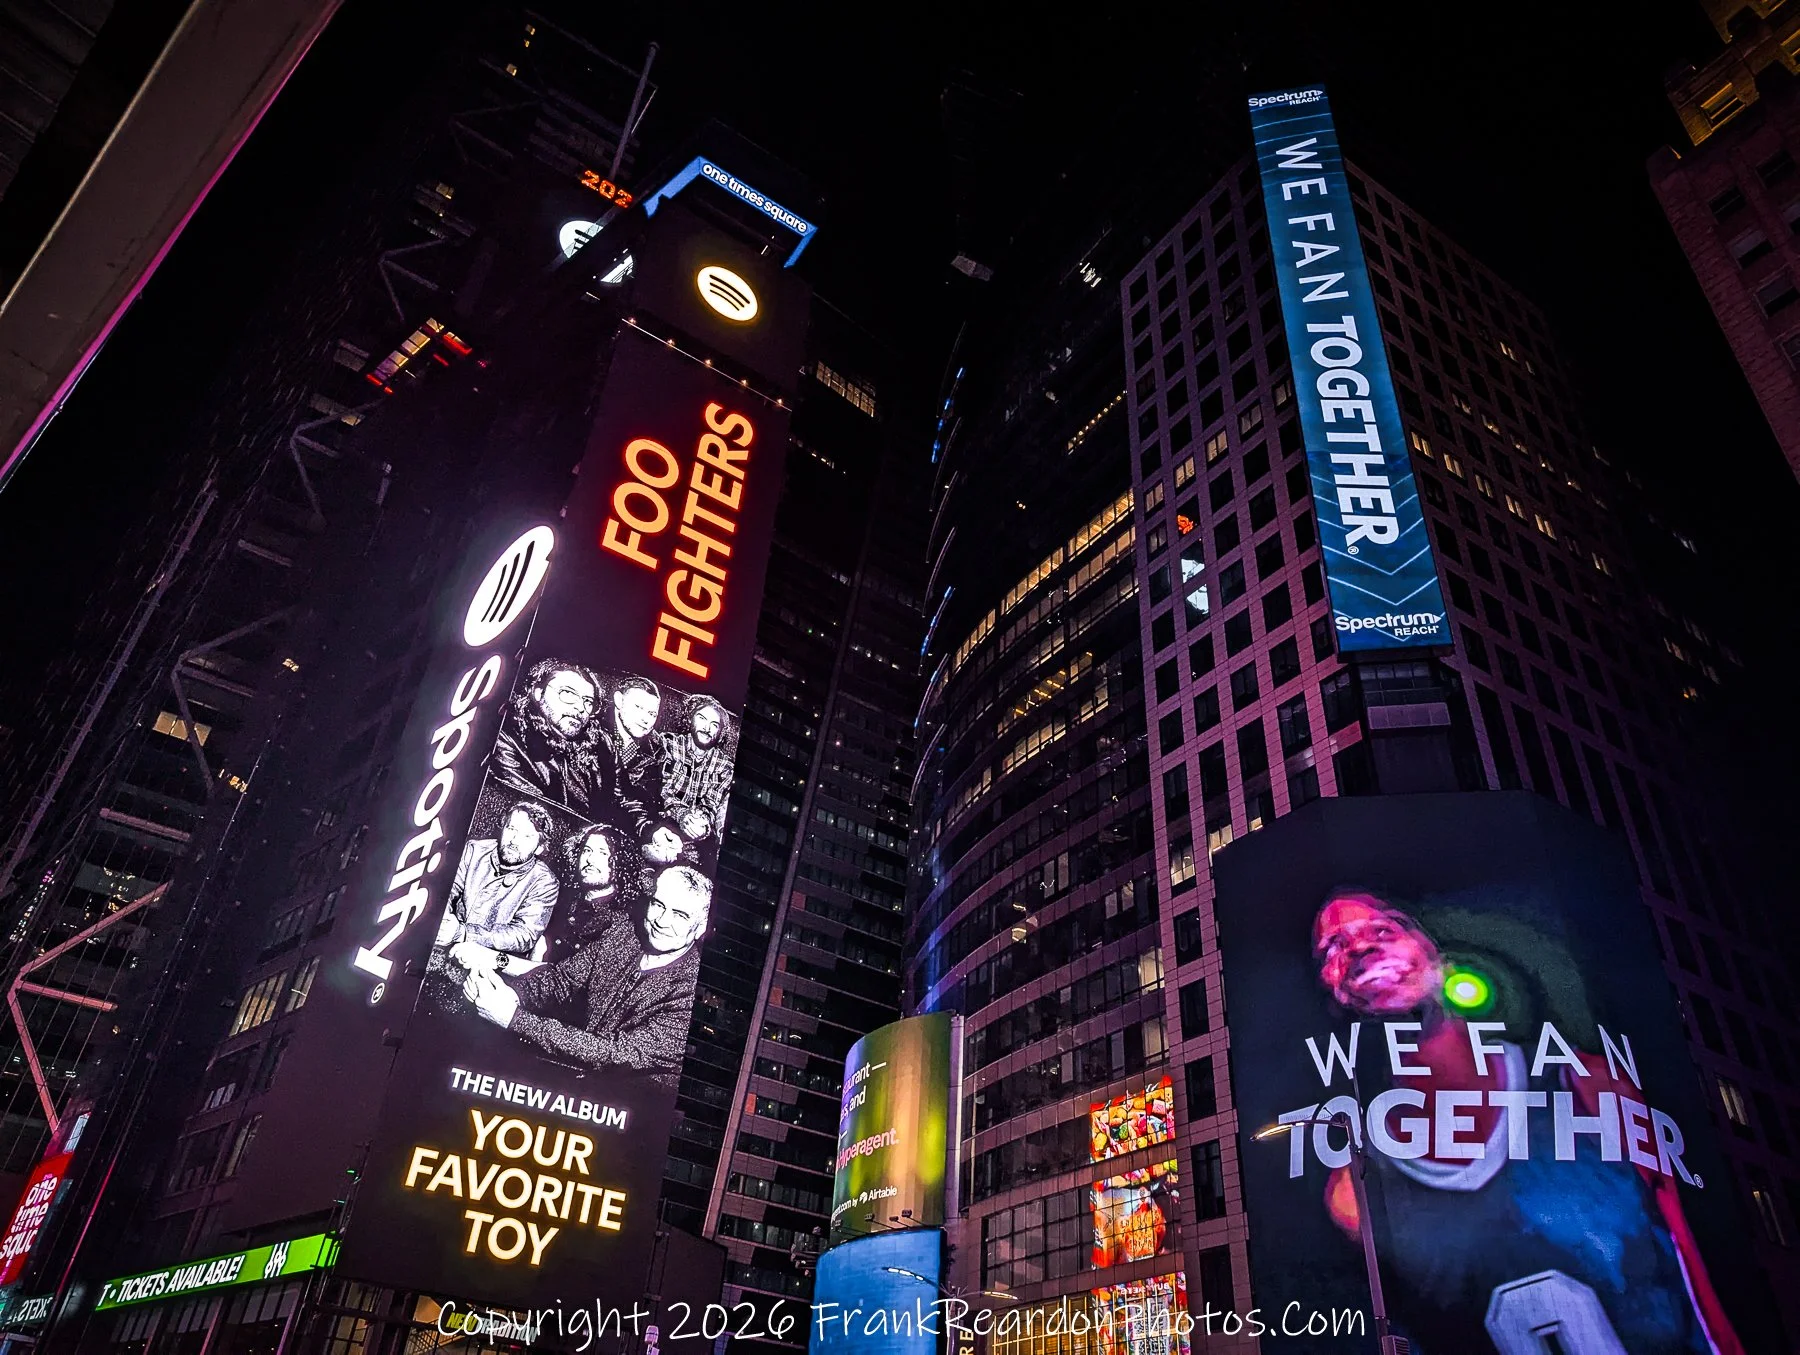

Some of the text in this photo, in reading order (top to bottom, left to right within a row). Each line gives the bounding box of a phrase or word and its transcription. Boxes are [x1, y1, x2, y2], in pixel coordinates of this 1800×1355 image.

[1248, 90, 1319, 107] Spectrum
[702, 162, 808, 233] one times square
[1275, 137, 1328, 201] WE
[1288, 212, 1350, 303] FAN
[601, 438, 680, 570] FOO
[652, 401, 754, 679] FIGHTERS
[1334, 612, 1434, 634] Spectrum
[1305, 1021, 1642, 1091] WE FAN
[450, 1067, 628, 1131] THE NEW ALBUM
[850, 1085, 867, 1111] and
[470, 1109, 594, 1176] YOUR
[25, 1176, 58, 1208] one
[404, 1146, 628, 1232] FAVORITE
[868, 1185, 898, 1201] Airtable
[463, 1209, 561, 1267] TOY
[116, 1271, 170, 1303] TICKETS
[165, 1255, 247, 1294] AVAILABLE!
[446, 1312, 478, 1332] NEW
